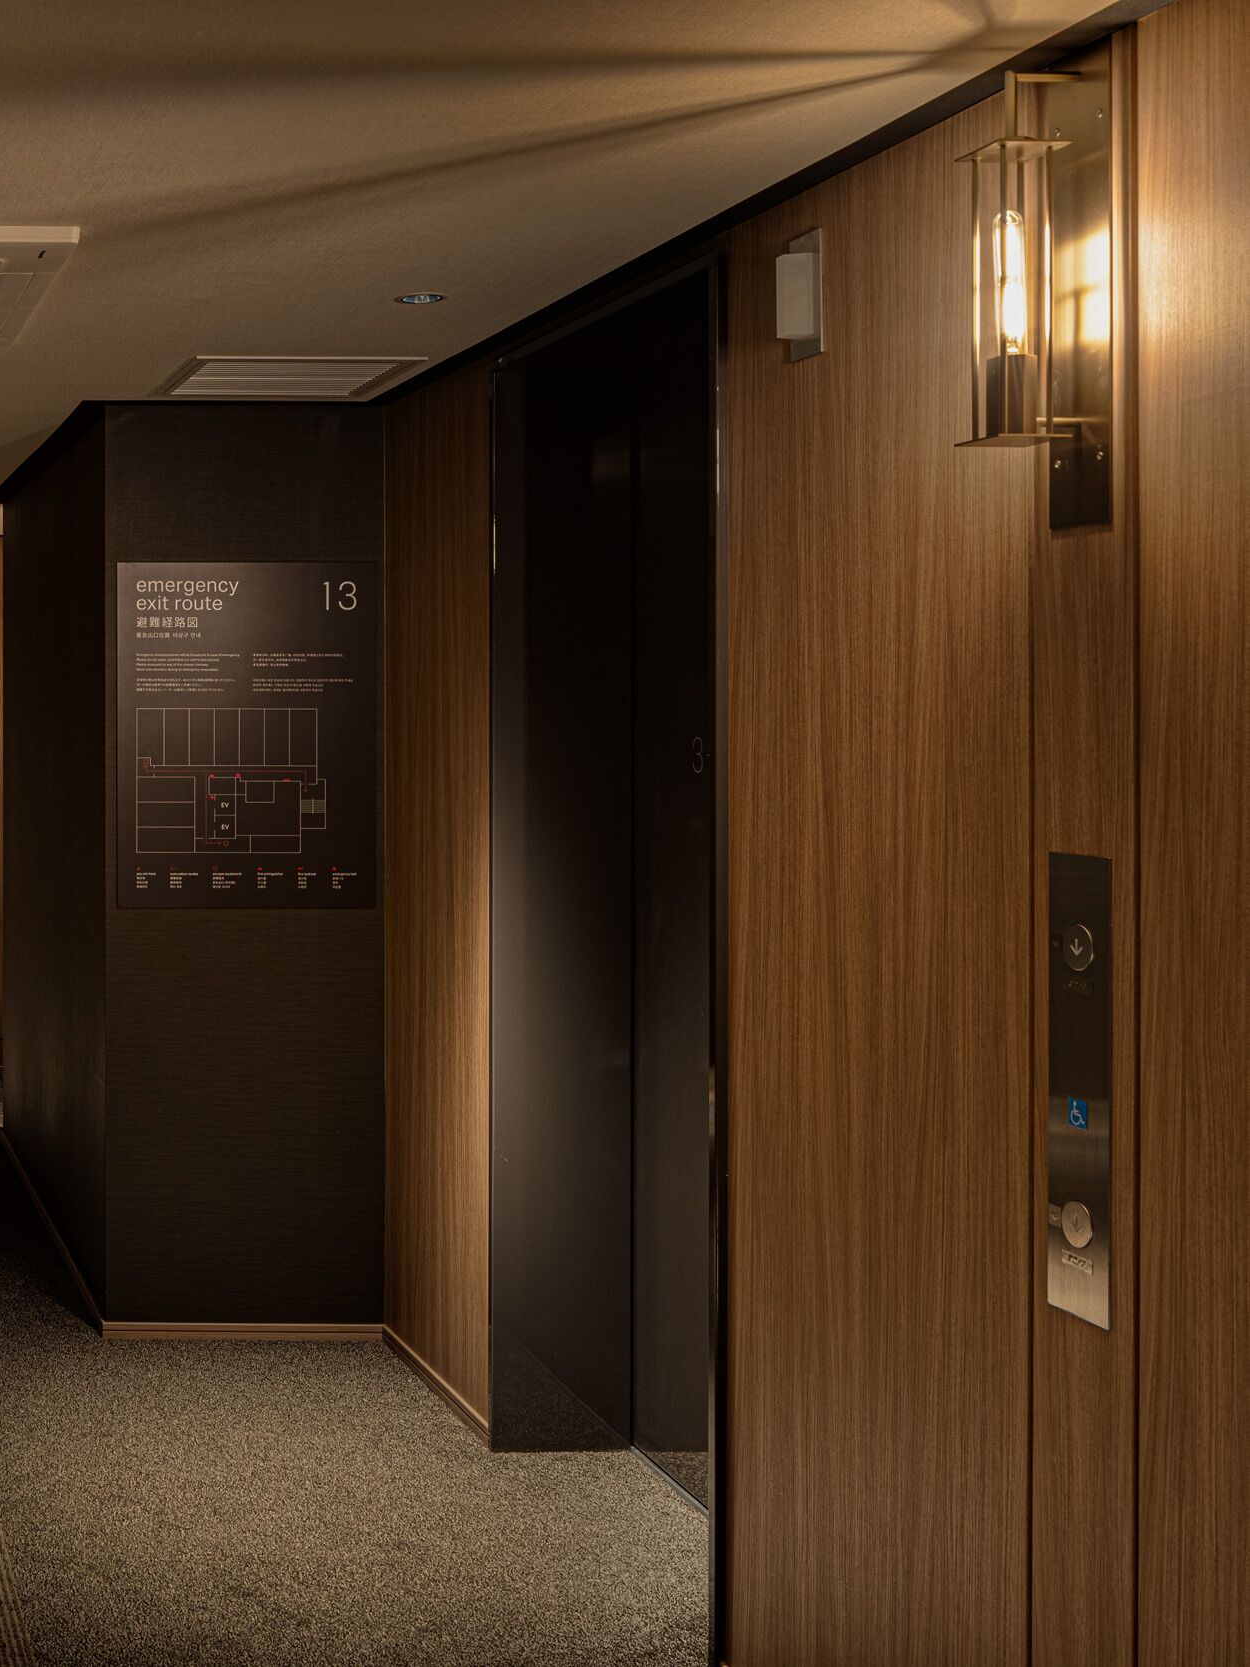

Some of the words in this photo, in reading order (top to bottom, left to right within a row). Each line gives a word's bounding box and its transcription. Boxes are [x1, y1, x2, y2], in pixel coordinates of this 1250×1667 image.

[136, 579, 239, 597] emergency
[322, 580, 357, 611] 13
[136, 596, 169, 611] exit
[174, 597, 223, 611] route
[136, 616, 198, 628] 避難経路図
